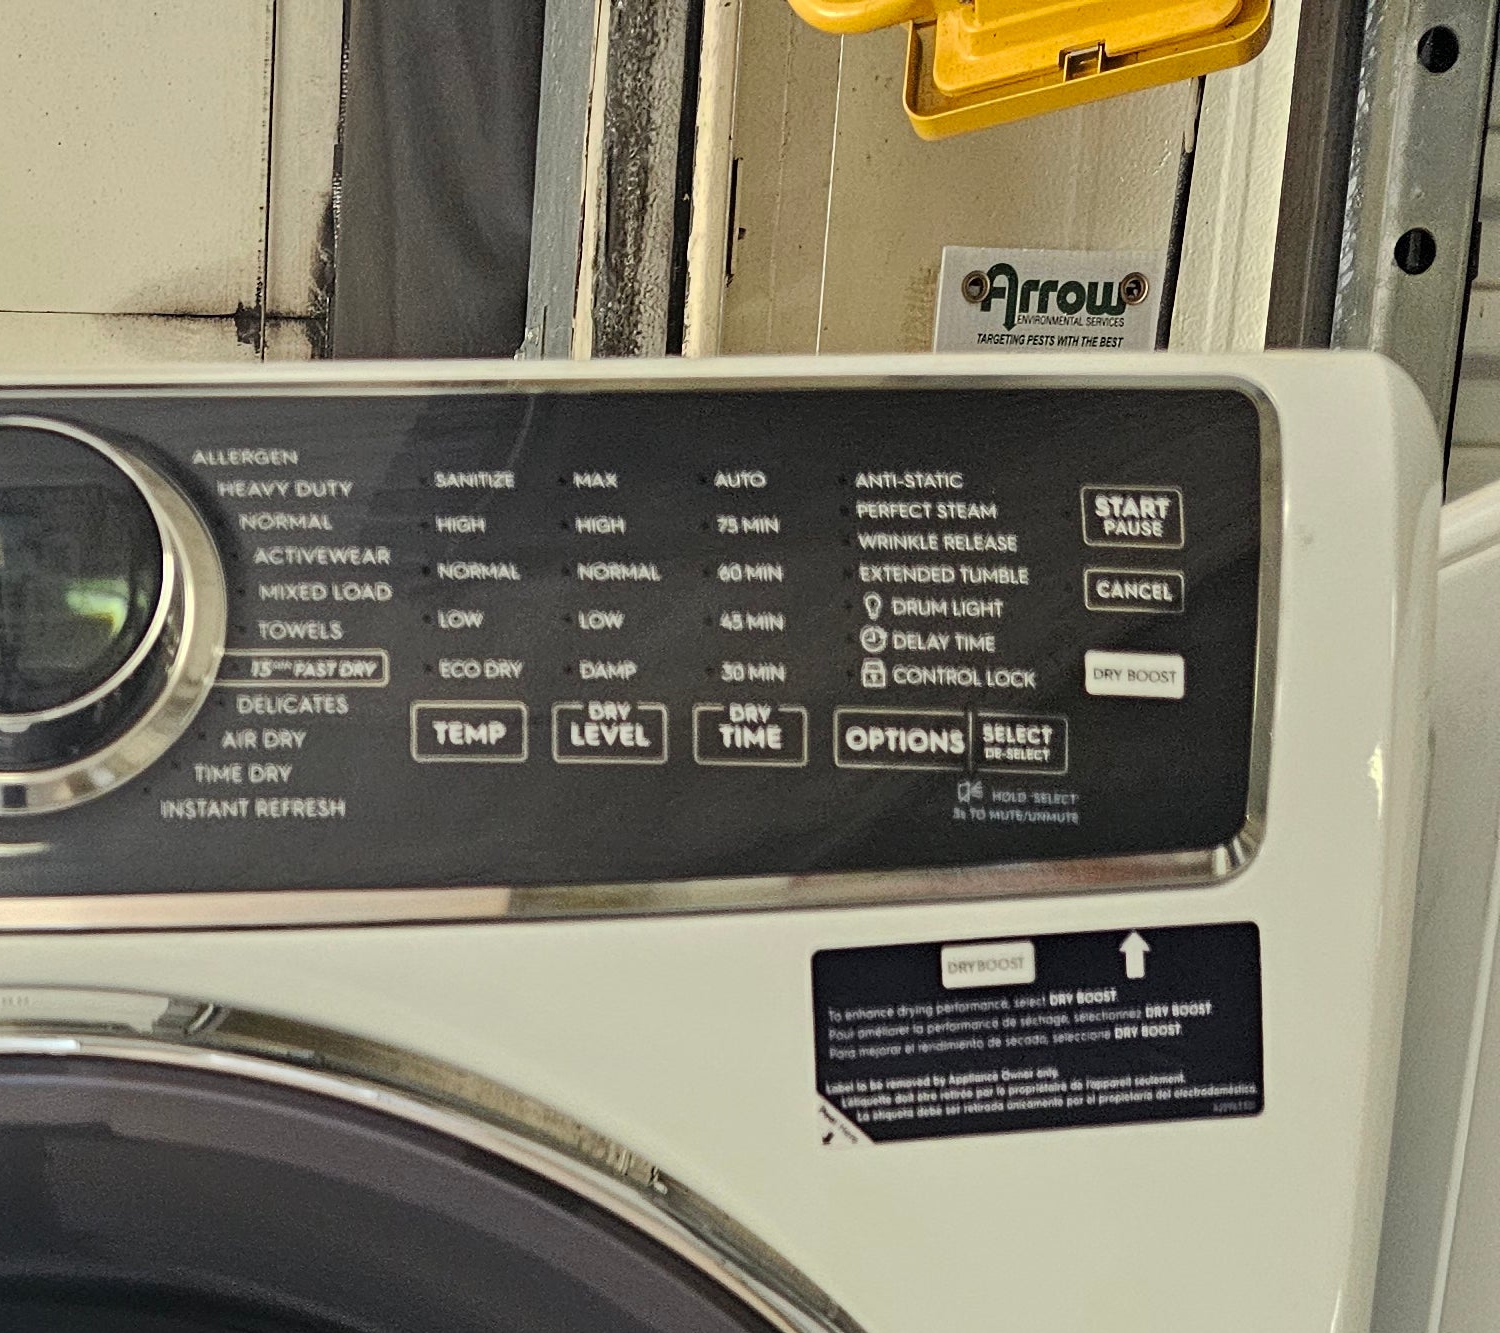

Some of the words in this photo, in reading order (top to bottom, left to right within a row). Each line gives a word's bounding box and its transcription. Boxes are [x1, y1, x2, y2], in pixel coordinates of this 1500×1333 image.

[980, 263, 1126, 331] Arrow
[1017, 315, 1083, 326] ENVIRONMENTAL
[1086, 317, 1124, 327] SERVICES
[977, 334, 1024, 345] TARGETING
[1027, 335, 1055, 346] PESTS
[1057, 336, 1079, 347] WITH
[1081, 337, 1098, 347] THE
[1100, 337, 1123, 348] BEST
[193, 448, 297, 465] ALLERGEN
[435, 472, 515, 489] SANITIZE
[574, 473, 617, 489] MAX
[715, 472, 766, 489] AUTO
[856, 473, 963, 489] ANTI-STATIC
[218, 481, 288, 498] HEAVY
[296, 481, 352, 498] DUTY
[857, 503, 931, 519] PERFECT
[936, 503, 996, 519] STEAM
[1095, 496, 1169, 519] START
[241, 514, 332, 531] NORMAL
[437, 517, 485, 534] HIGH
[577, 517, 625, 534] HIGH
[718, 517, 739, 534] 75
[743, 517, 778, 534] MIN
[1104, 519, 1163, 536] PAUSE
[859, 534, 938, 551] WRINKLE
[943, 534, 1017, 551] RELEASE
[254, 548, 390, 565] ACTIVEWEAR
[438, 563, 520, 580] NORMAL
[578, 564, 660, 581] NORMAL
[718, 565, 741, 582] 60
[745, 565, 783, 582] MIN
[860, 566, 955, 583] EXTENDED
[960, 566, 1028, 585] TUMBLE
[259, 583, 326, 600] MIXED
[333, 583, 392, 600] LOAD
[1097, 581, 1172, 601] CANCEL
[893, 600, 947, 616] DRUM
[952, 600, 1003, 617] LIGHT
[439, 611, 484, 628] LOW
[579, 611, 623, 629] LOW
[720, 613, 742, 631] 45
[747, 614, 784, 631] MIN
[259, 622, 342, 640] TOWELS
[893, 633, 949, 652] DELAY
[955, 634, 995, 653] TIME
[339, 660, 377, 677] DRY
[439, 661, 479, 678] ECO
[484, 661, 522, 678] DRY
[580, 662, 636, 679] DAMP
[722, 663, 743, 681] 30
[748, 663, 785, 682] MIN
[1093, 668, 1123, 683] DRY
[1127, 668, 1177, 685] BOOST
[894, 668, 981, 687] CONTROL
[987, 669, 1035, 688] LOCK
[237, 696, 348, 715] DELICATES
[588, 702, 630, 723] DRY
[729, 704, 770, 724] DRY
[222, 731, 256, 748] AIR
[261, 731, 305, 748] DRY
[433, 723, 506, 745] TEMP
[572, 723, 649, 747] LEVEL
[720, 726, 782, 749] TIME
[845, 727, 964, 754] OPTIONS
[983, 722, 1052, 744] SELECT
[984, 748, 1050, 762] DE-SELECT
[196, 765, 241, 783] TIME
[248, 765, 291, 783] DRY
[992, 792, 1026, 802] HOLD
[1033, 792, 1078, 804] SELECT
[161, 799, 248, 818] INSTANT
[255, 799, 345, 818] REFRESH
[970, 808, 986, 820] TO
[989, 809, 1079, 824] MUTE/UNMUTE
[948, 959, 976, 974] DRY
[977, 956, 1024, 973] BOOST
[828, 1009, 841, 1020] To
[845, 1006, 893, 1019] enhance
[897, 1003, 932, 1017] drying
[1049, 993, 1072, 1006] DRY
[1002, 1016, 1015, 1028] de
[1145, 1006, 1168, 1019] DRY
[987, 1036, 1001, 1048] de
[1114, 1027, 1137, 1039] DRY
[826, 1080, 852, 1093] Label
[870, 1078, 882, 1090] be
[886, 1076, 929, 1089] removed
[933, 1074, 944, 1087] by
[949, 1071, 997, 1085] Appliance
[1001, 1068, 1033, 1081] Owner
